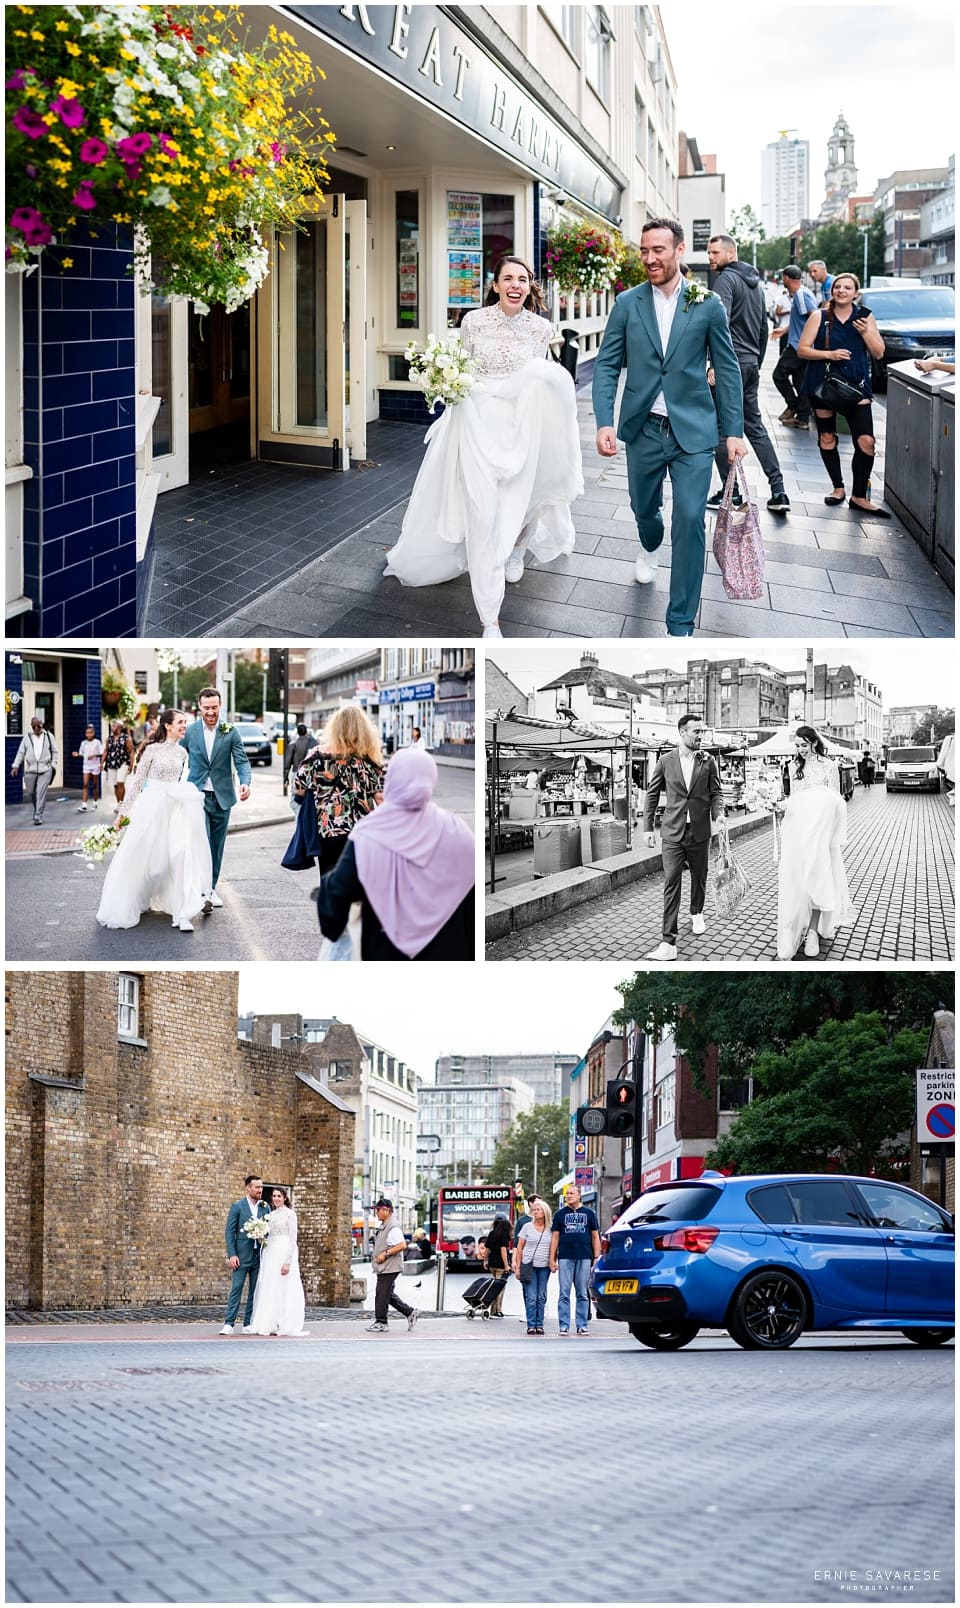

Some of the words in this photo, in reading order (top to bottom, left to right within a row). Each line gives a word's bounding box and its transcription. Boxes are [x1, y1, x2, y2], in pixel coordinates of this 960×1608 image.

[490, 83, 564, 173] HARRY
[926, 1082, 955, 1090] parkin
[926, 1091, 955, 1101] ZON
[445, 1191, 482, 1199] BARBER
[483, 1190, 509, 1199] SHOP
[454, 1204, 496, 1212] WOOLWICH
